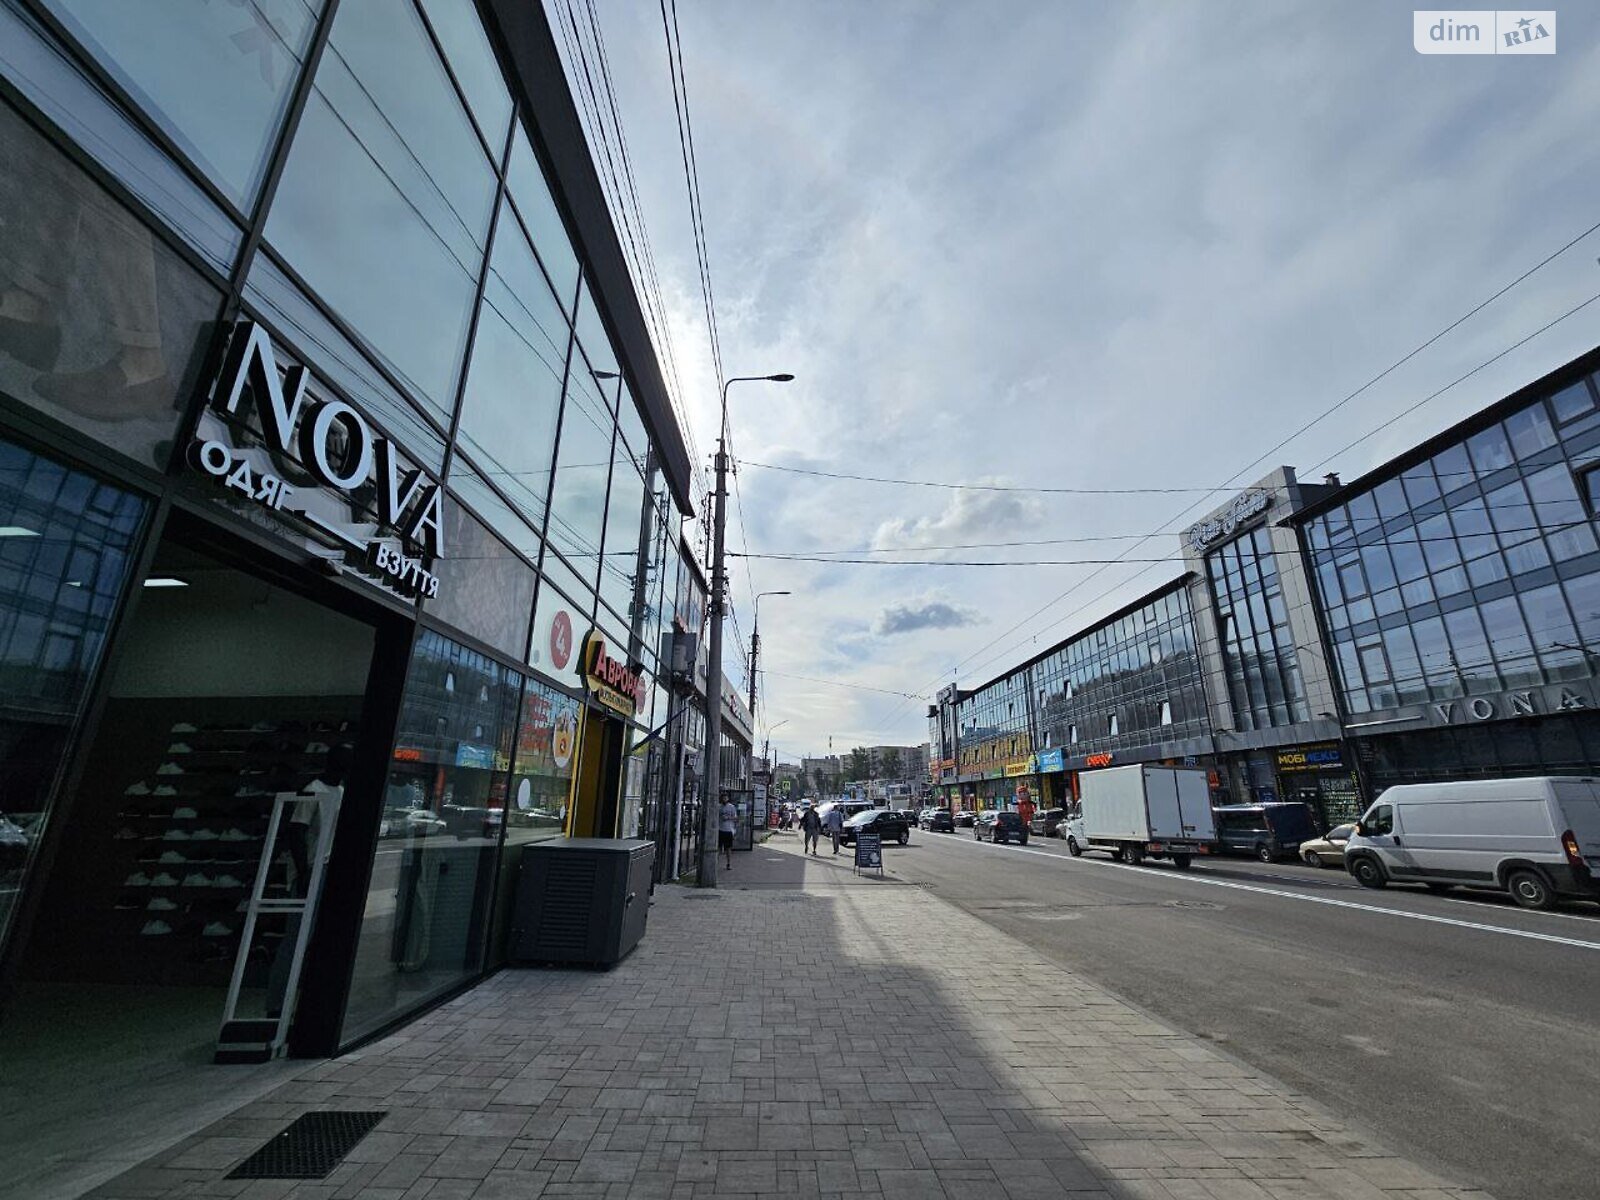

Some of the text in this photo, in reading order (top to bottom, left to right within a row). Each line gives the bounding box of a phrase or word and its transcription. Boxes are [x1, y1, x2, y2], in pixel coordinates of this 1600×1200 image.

[200, 439, 439, 599] ОДЯГ ВЗУТТЯ
[226, 321, 445, 559] NOVA
[1434, 688, 1585, 724] VONA
